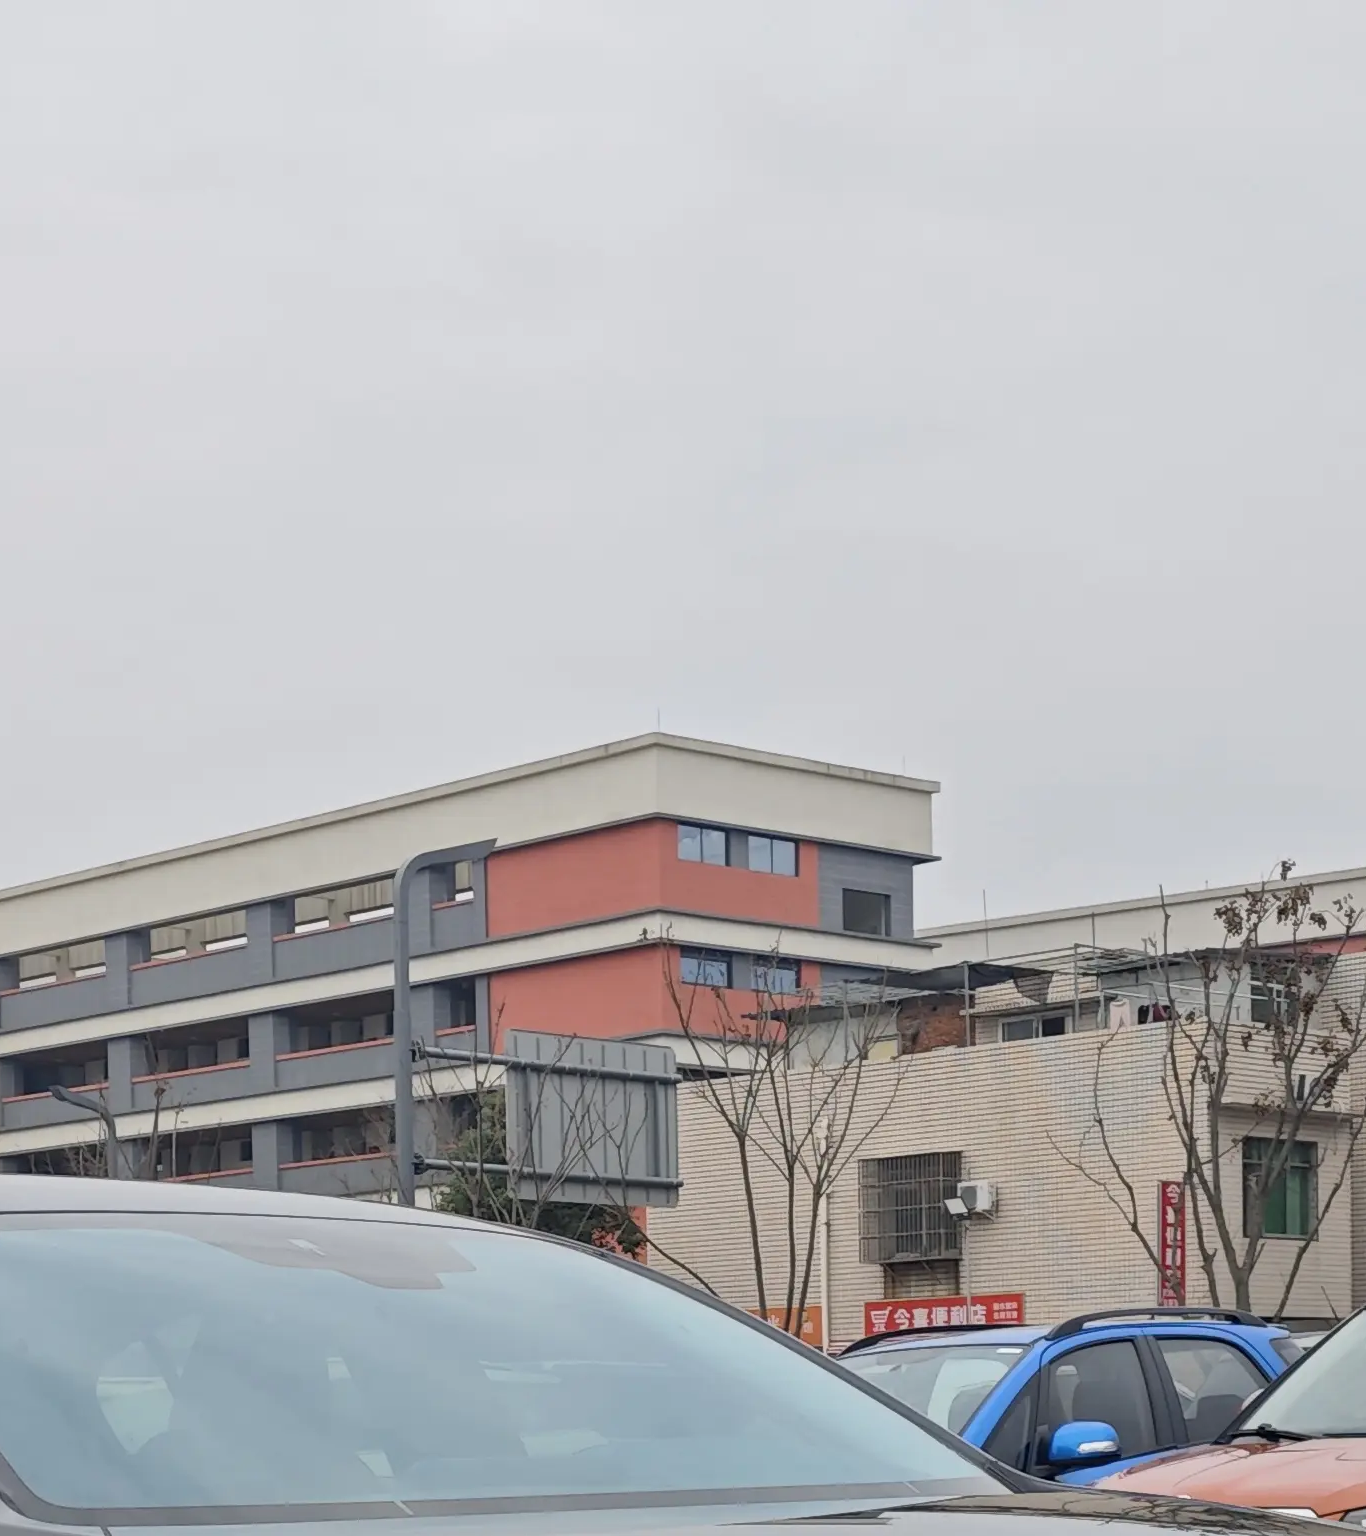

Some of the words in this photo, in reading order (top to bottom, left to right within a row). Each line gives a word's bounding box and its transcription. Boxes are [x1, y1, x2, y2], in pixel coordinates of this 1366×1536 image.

[893, 1303, 987, 1330] 今喜便利店
